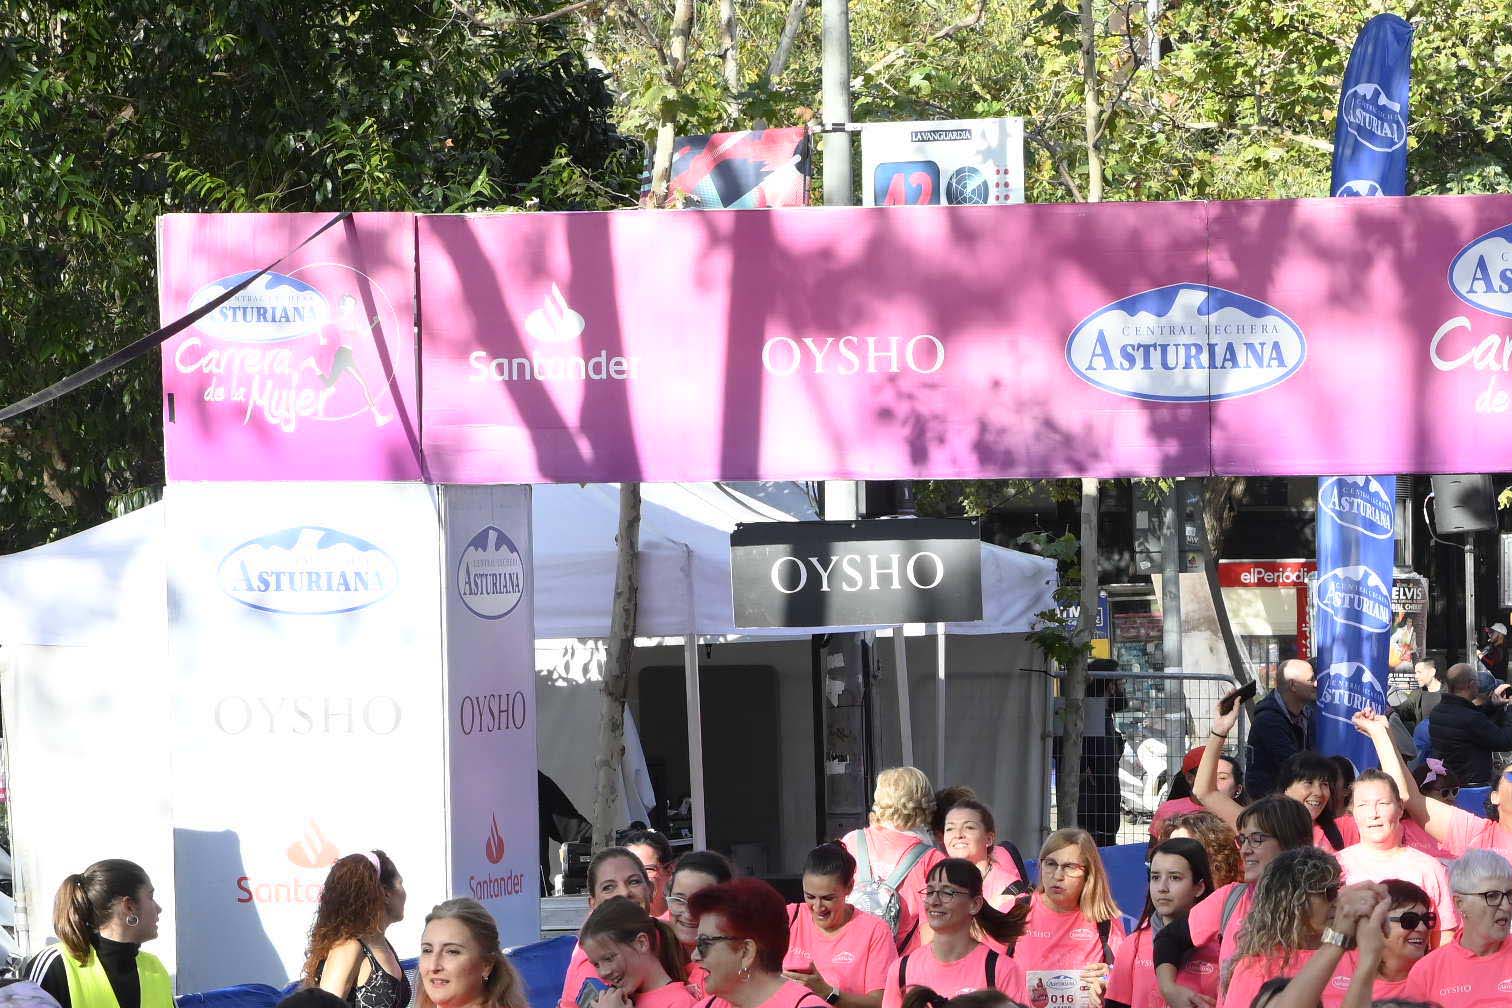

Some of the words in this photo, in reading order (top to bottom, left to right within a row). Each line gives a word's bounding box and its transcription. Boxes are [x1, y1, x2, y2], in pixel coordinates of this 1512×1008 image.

[1121, 322, 1197, 337] CENTRAL
[1203, 322, 1279, 336] LECHERA
[175, 337, 293, 385] Carrera
[468, 347, 641, 383] Santander
[762, 333, 945, 375] OYSHO
[1085, 328, 1287, 372] ASTURIANA
[203, 379, 225, 402] de
[231, 382, 246, 402] la
[244, 374, 336, 433] Mujer
[1475, 378, 1510, 414] de
[231, 559, 386, 593] ASTURIANA
[463, 561, 521, 597] ASTURIANA
[770, 551, 944, 595] OYSHO
[1392, 586, 1422, 599] ELVIS
[214, 695, 403, 736] OYSHO
[461, 691, 526, 735] OYSHO
[236, 875, 324, 905] Santa
[469, 871, 524, 902] Santander
[1050, 994, 1074, 1003] 016
